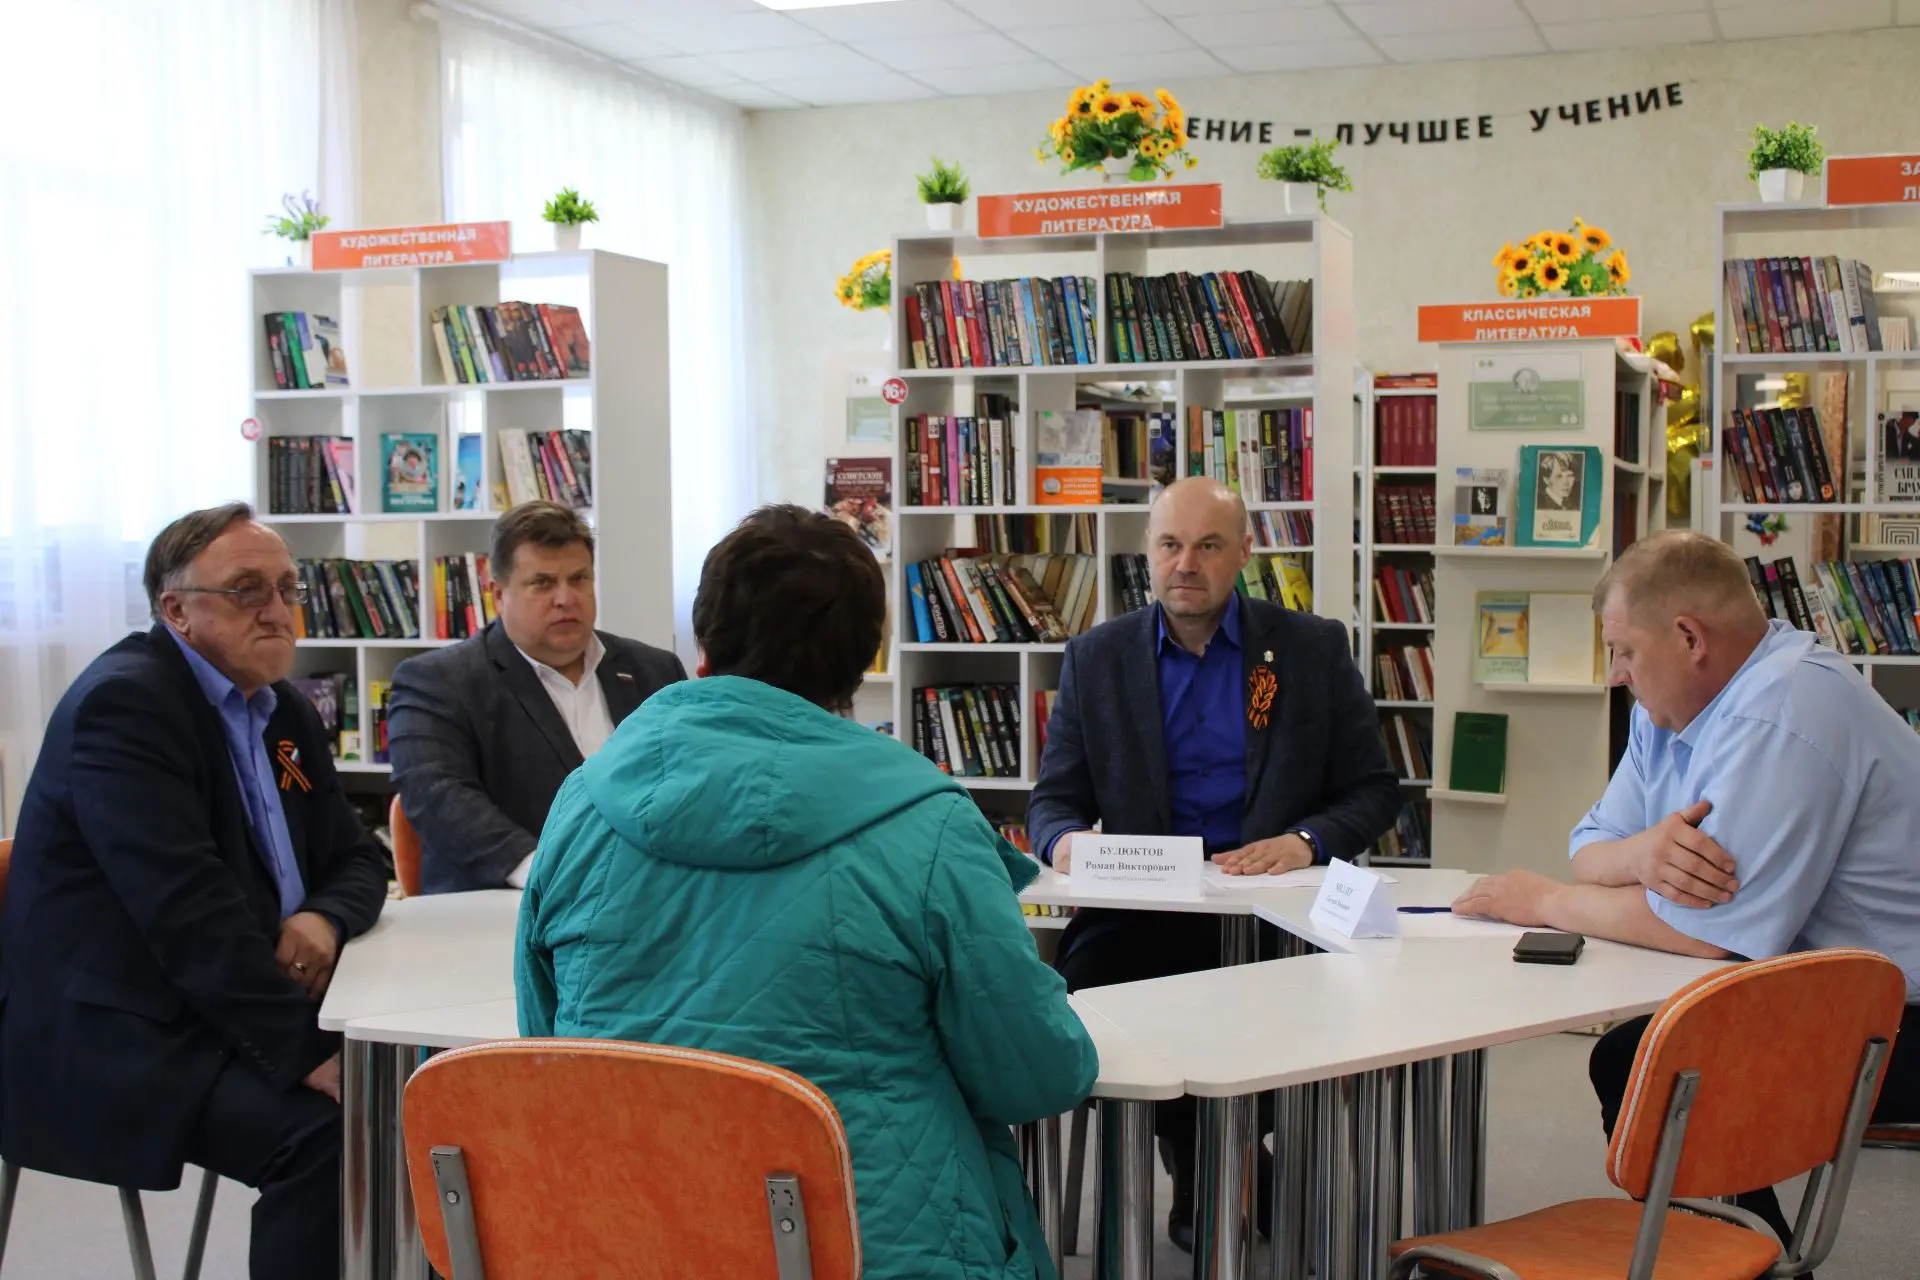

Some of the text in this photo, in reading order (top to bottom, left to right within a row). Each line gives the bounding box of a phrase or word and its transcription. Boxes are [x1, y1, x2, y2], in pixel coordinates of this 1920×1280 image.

[1336, 115, 1493, 145] ЛУЧШЕЕ
[1530, 82, 1684, 132] УЧЕНИЕ
[1013, 191, 1182, 214] ХУДОЖЕСТВЕННАЯ
[1041, 214, 1153, 234] ЛИТЕРАТУРА
[340, 228, 476, 250] ХУДОЖЕСТВЕННАЯ
[362, 251, 455, 268] ЛИТЕРАТУРА
[1463, 304, 1591, 322] КЛАССИЧЕСКАЯ
[1476, 326, 1579, 341] ЛИТЕРАТУРА
[1099, 846, 1164, 857] БУЛЮКТОВ
[1085, 861, 1177, 873] Роман Викторович
